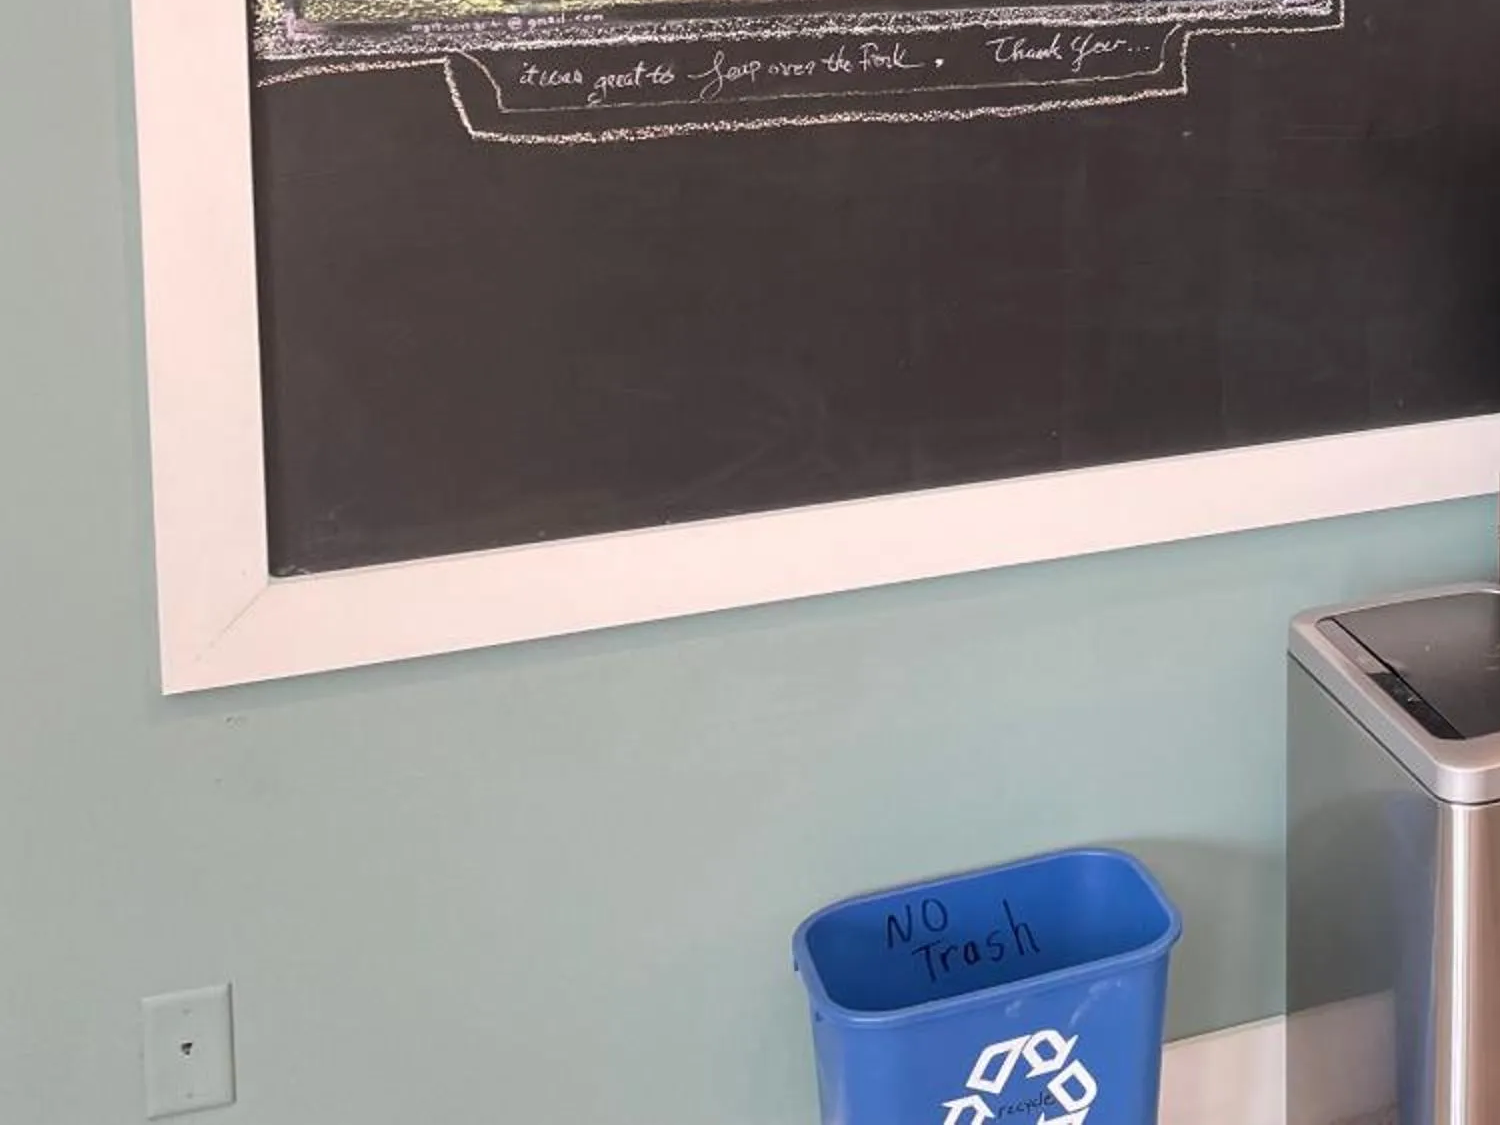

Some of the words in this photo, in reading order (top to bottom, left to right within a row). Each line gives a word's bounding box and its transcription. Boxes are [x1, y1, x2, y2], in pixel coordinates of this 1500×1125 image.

[587, 60, 647, 107] great
[645, 63, 675, 85] to
[768, 60, 816, 76] over
[820, 45, 851, 73] the
[985, 32, 1063, 63] Thank
[886, 896, 949, 951] NO
[911, 898, 1041, 983] Trash
